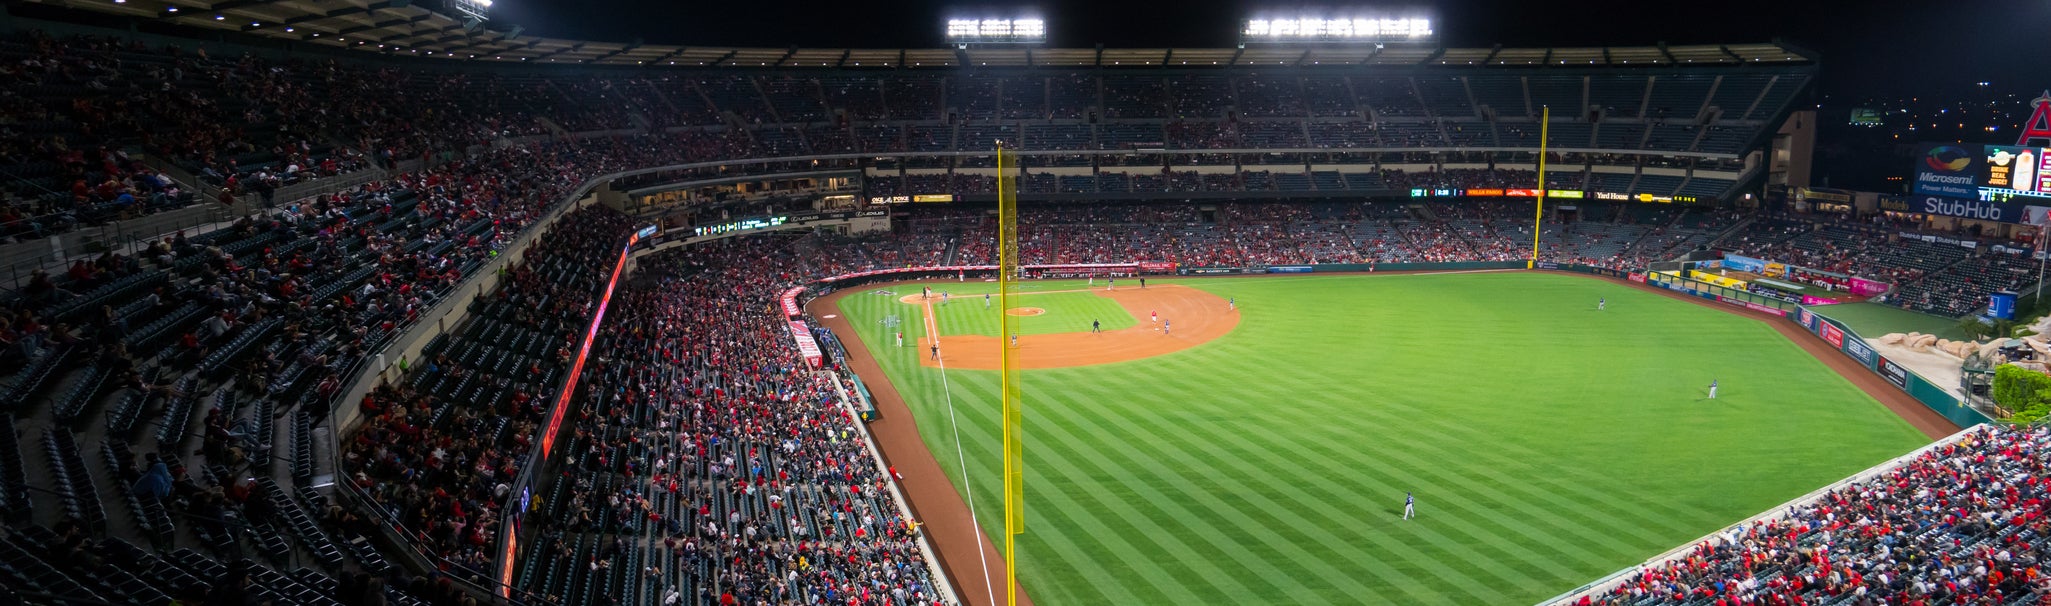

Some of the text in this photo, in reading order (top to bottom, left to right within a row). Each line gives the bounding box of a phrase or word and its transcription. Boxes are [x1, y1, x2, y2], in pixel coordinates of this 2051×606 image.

[1597, 191, 1610, 200] Yard
[1610, 192, 1629, 201] House
[1925, 197, 2001, 220] StubHub
